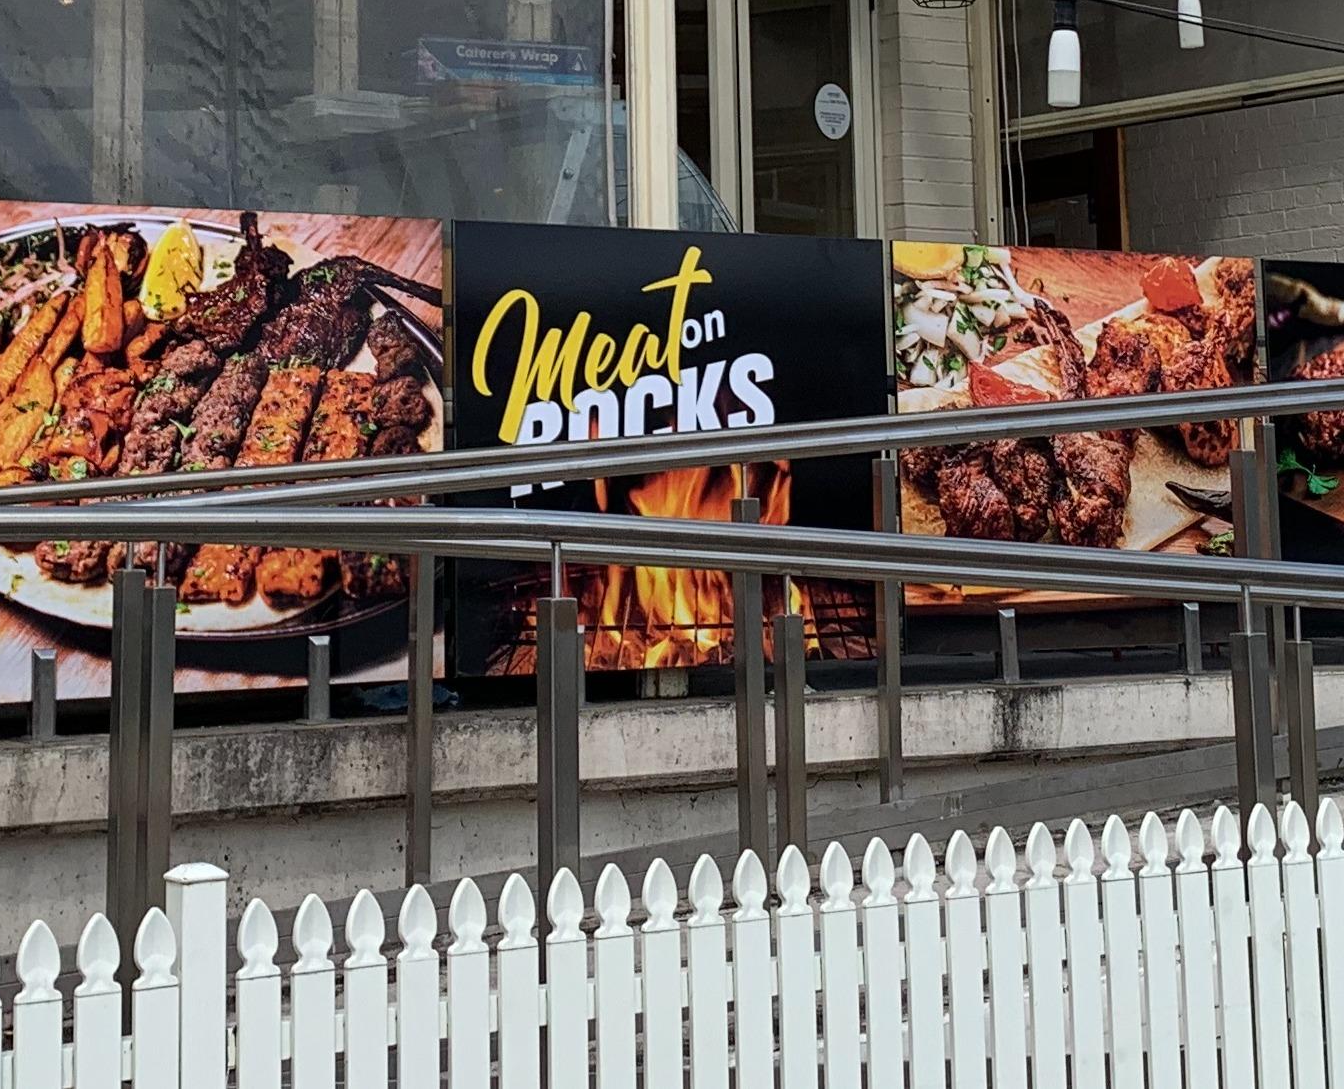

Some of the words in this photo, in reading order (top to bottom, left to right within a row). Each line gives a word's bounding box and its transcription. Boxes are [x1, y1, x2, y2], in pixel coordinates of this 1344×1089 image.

[520, 48, 559, 66] Wrap
[472, 245, 713, 444] Meat
[682, 309, 725, 349] on
